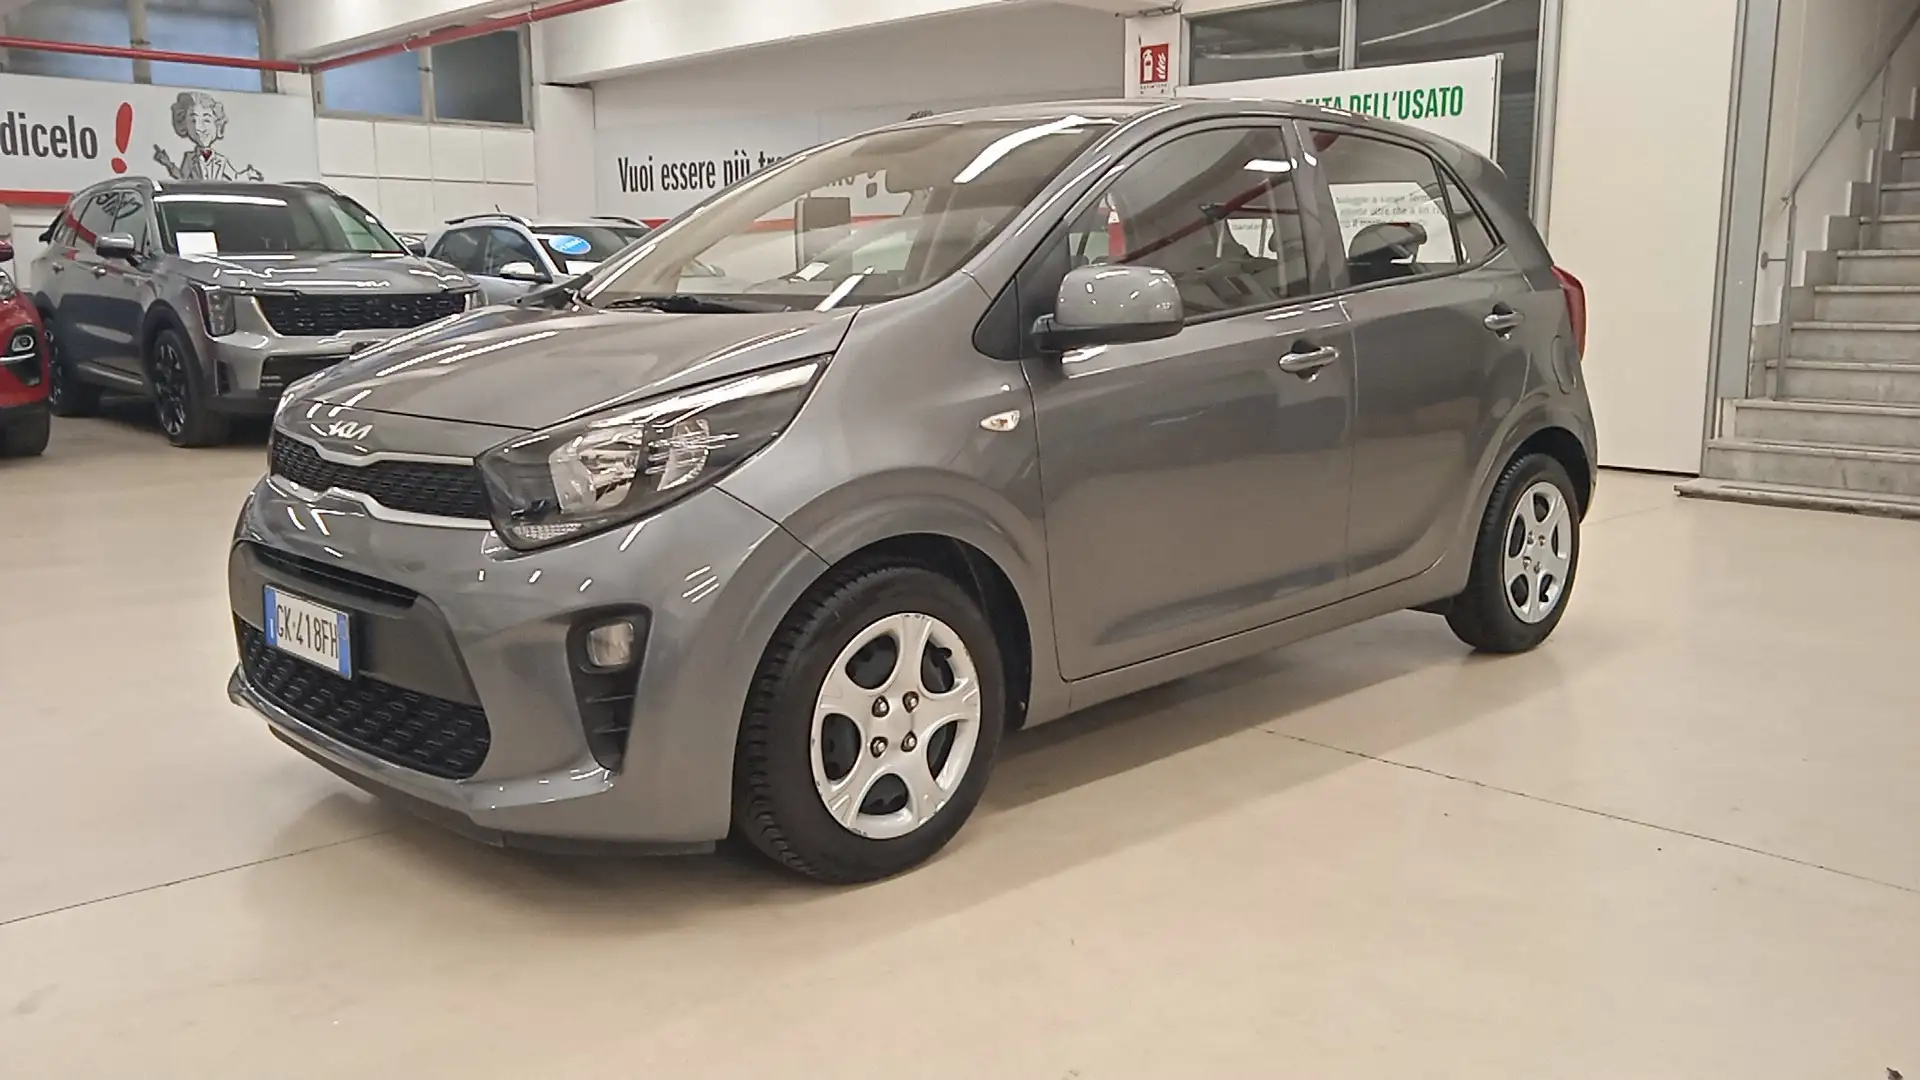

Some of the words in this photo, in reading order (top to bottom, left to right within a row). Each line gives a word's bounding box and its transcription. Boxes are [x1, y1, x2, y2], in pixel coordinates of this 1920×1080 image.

[0, 111, 98, 159] dicelo
[618, 155, 655, 192] Vuoi
[661, 159, 716, 191] essere
